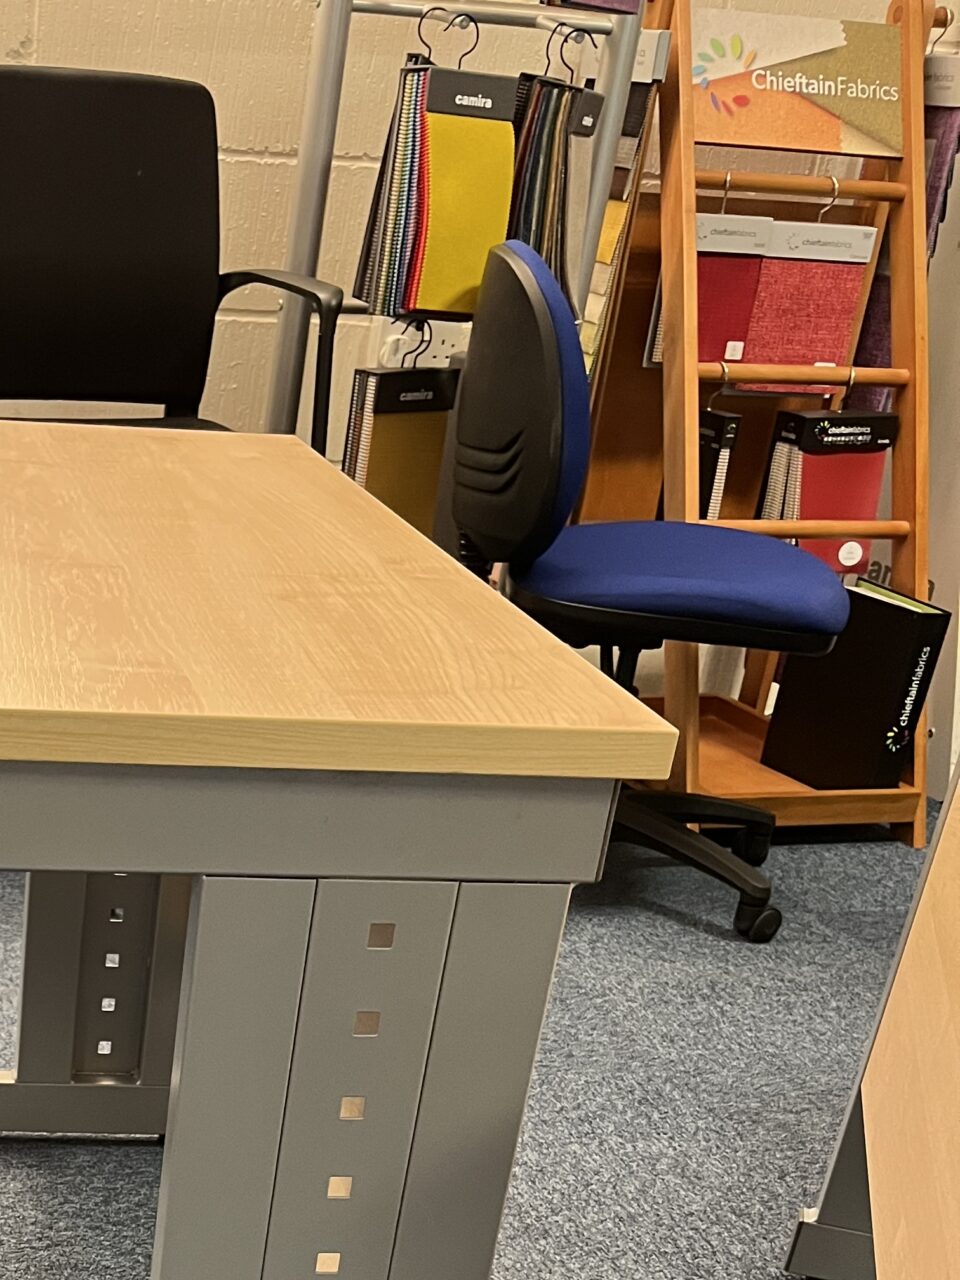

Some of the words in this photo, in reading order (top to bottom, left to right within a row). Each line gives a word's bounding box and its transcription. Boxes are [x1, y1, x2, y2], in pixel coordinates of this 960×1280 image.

[454, 93, 493, 109] camira
[751, 69, 900, 101] ChieftainFabrics
[899, 646, 931, 727] chieftainfabrics
